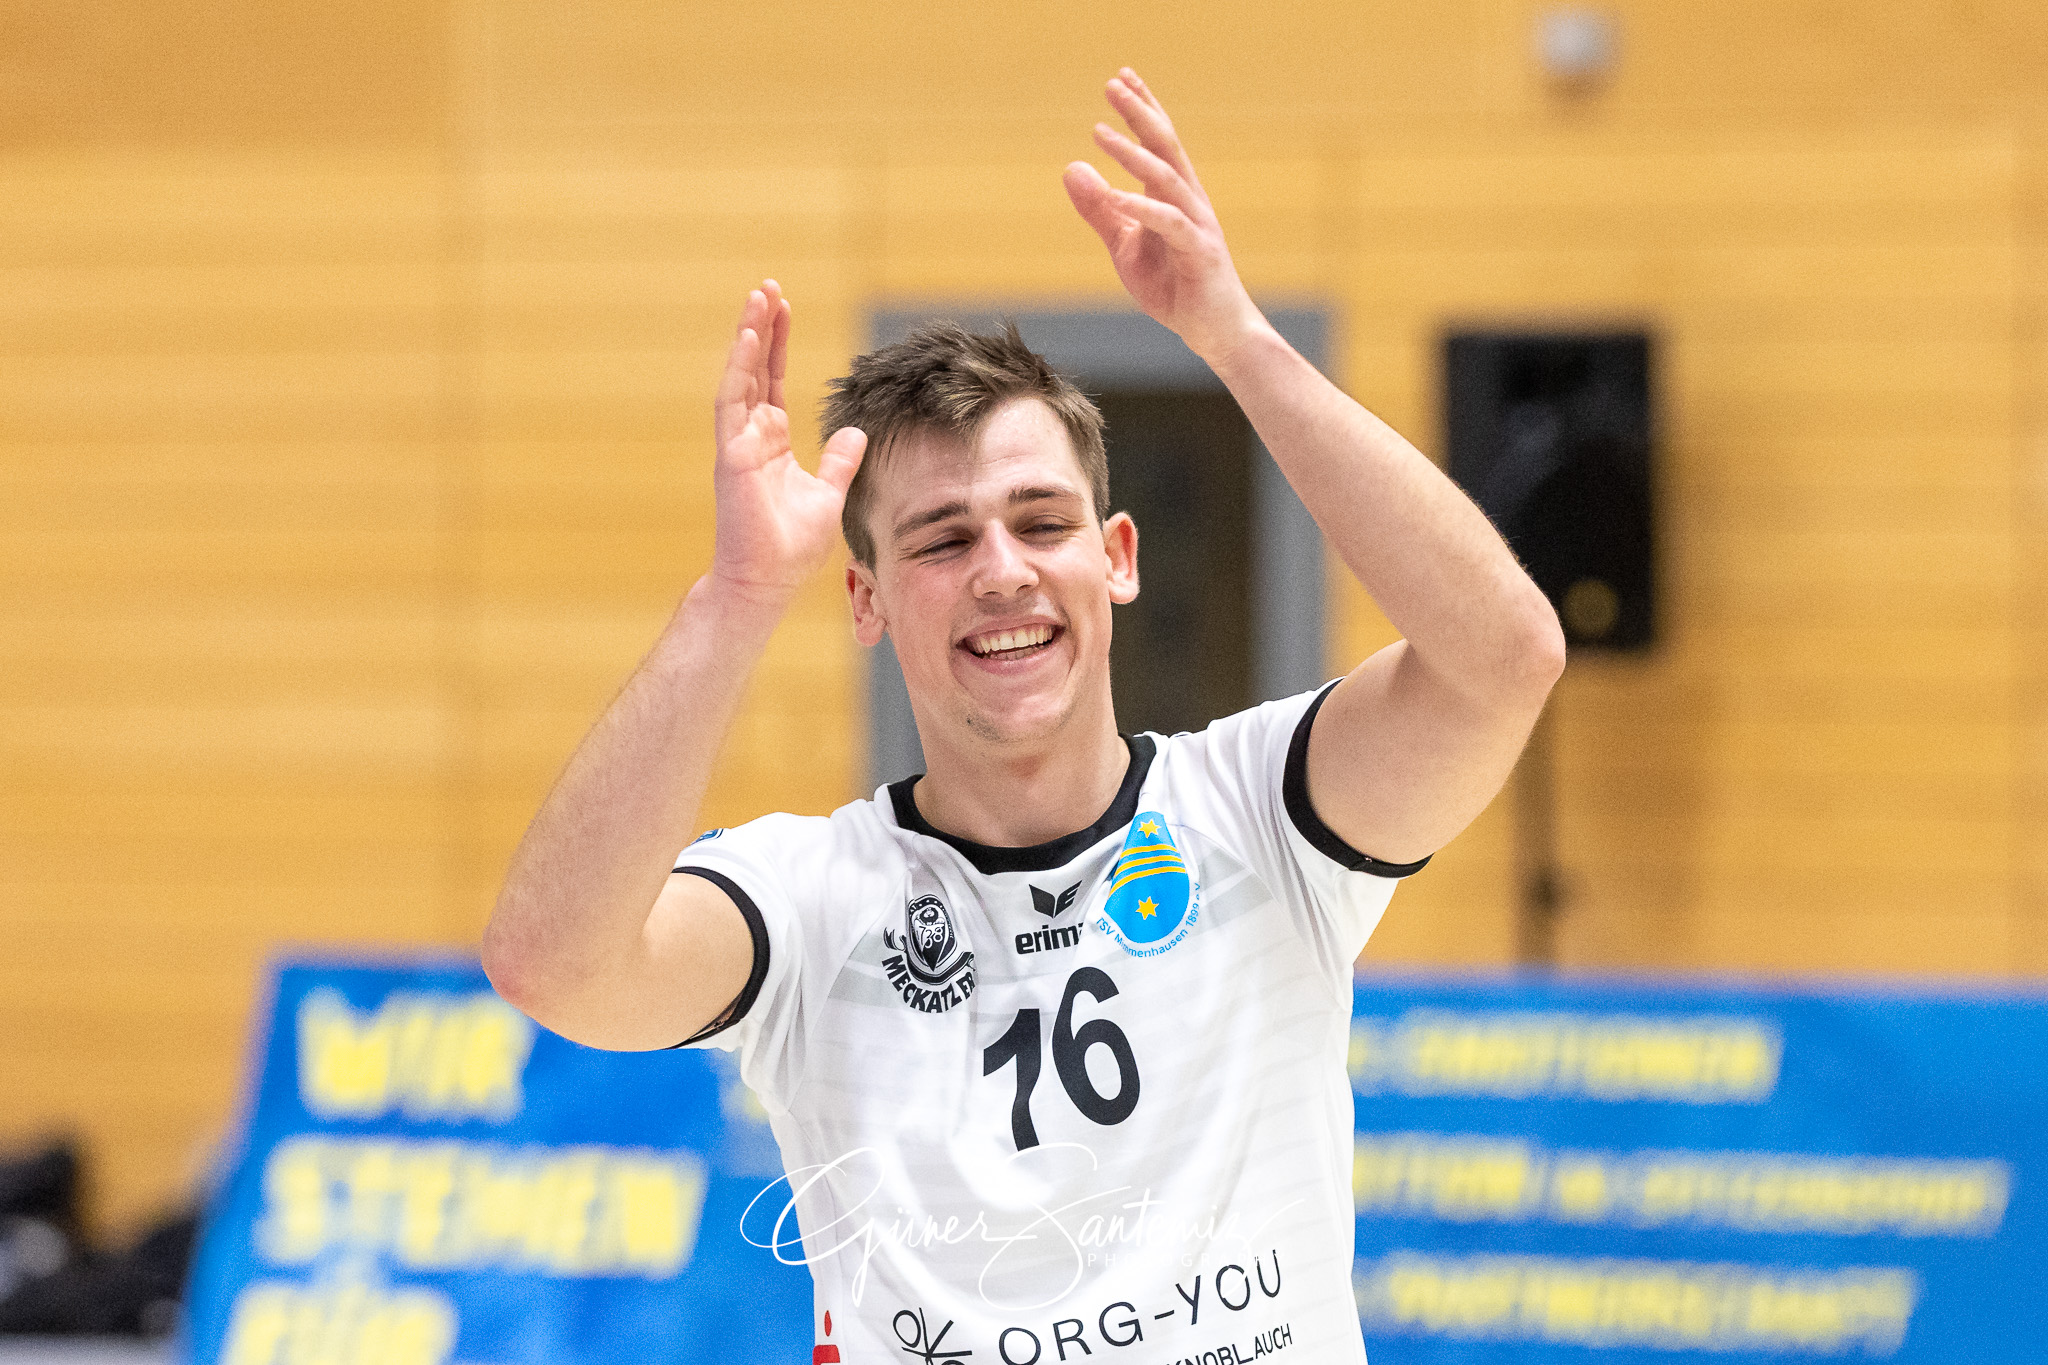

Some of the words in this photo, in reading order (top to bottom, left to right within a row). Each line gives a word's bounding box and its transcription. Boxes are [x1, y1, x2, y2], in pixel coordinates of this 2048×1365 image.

[1015, 922, 1083, 955] erim
[983, 966, 1141, 1152] 16
[998, 1249, 1281, 1365] ORG-YOU
